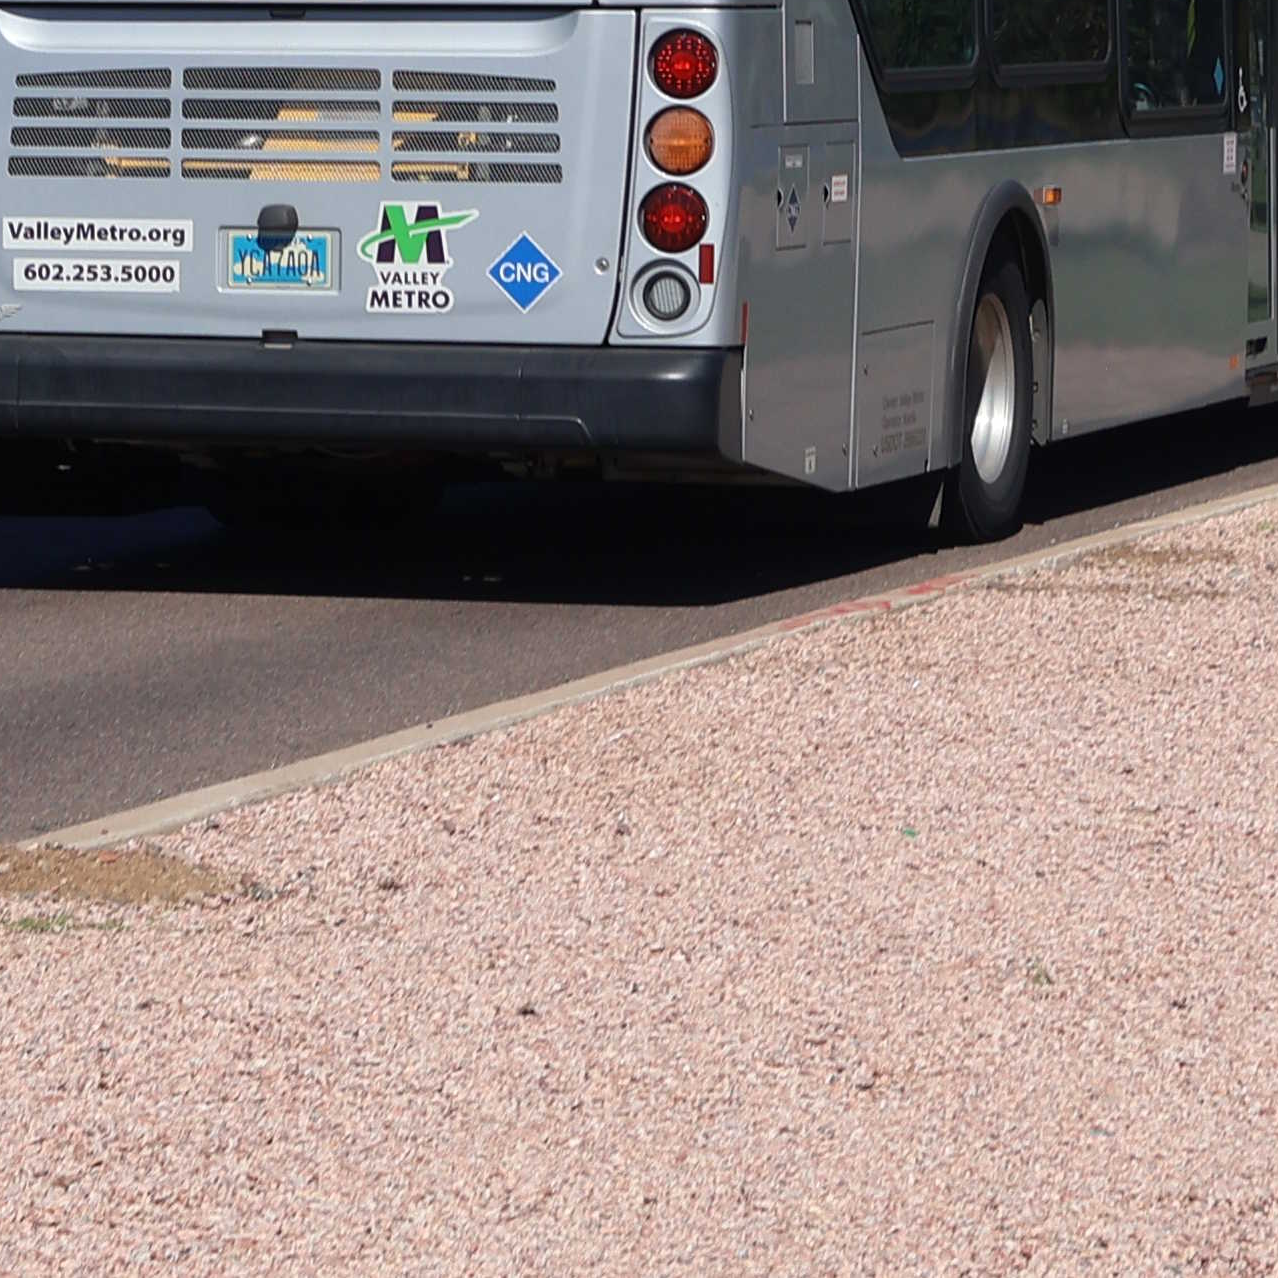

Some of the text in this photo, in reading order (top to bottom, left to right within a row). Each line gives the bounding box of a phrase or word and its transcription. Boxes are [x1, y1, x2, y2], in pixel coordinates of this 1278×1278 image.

[8, 221, 186, 247] ValleyMetro.org
[23, 263, 175, 284] 602.253.5000
[379, 271, 441, 286] VALLEY
[499, 262, 550, 283] CNG
[369, 289, 450, 309] METRO
